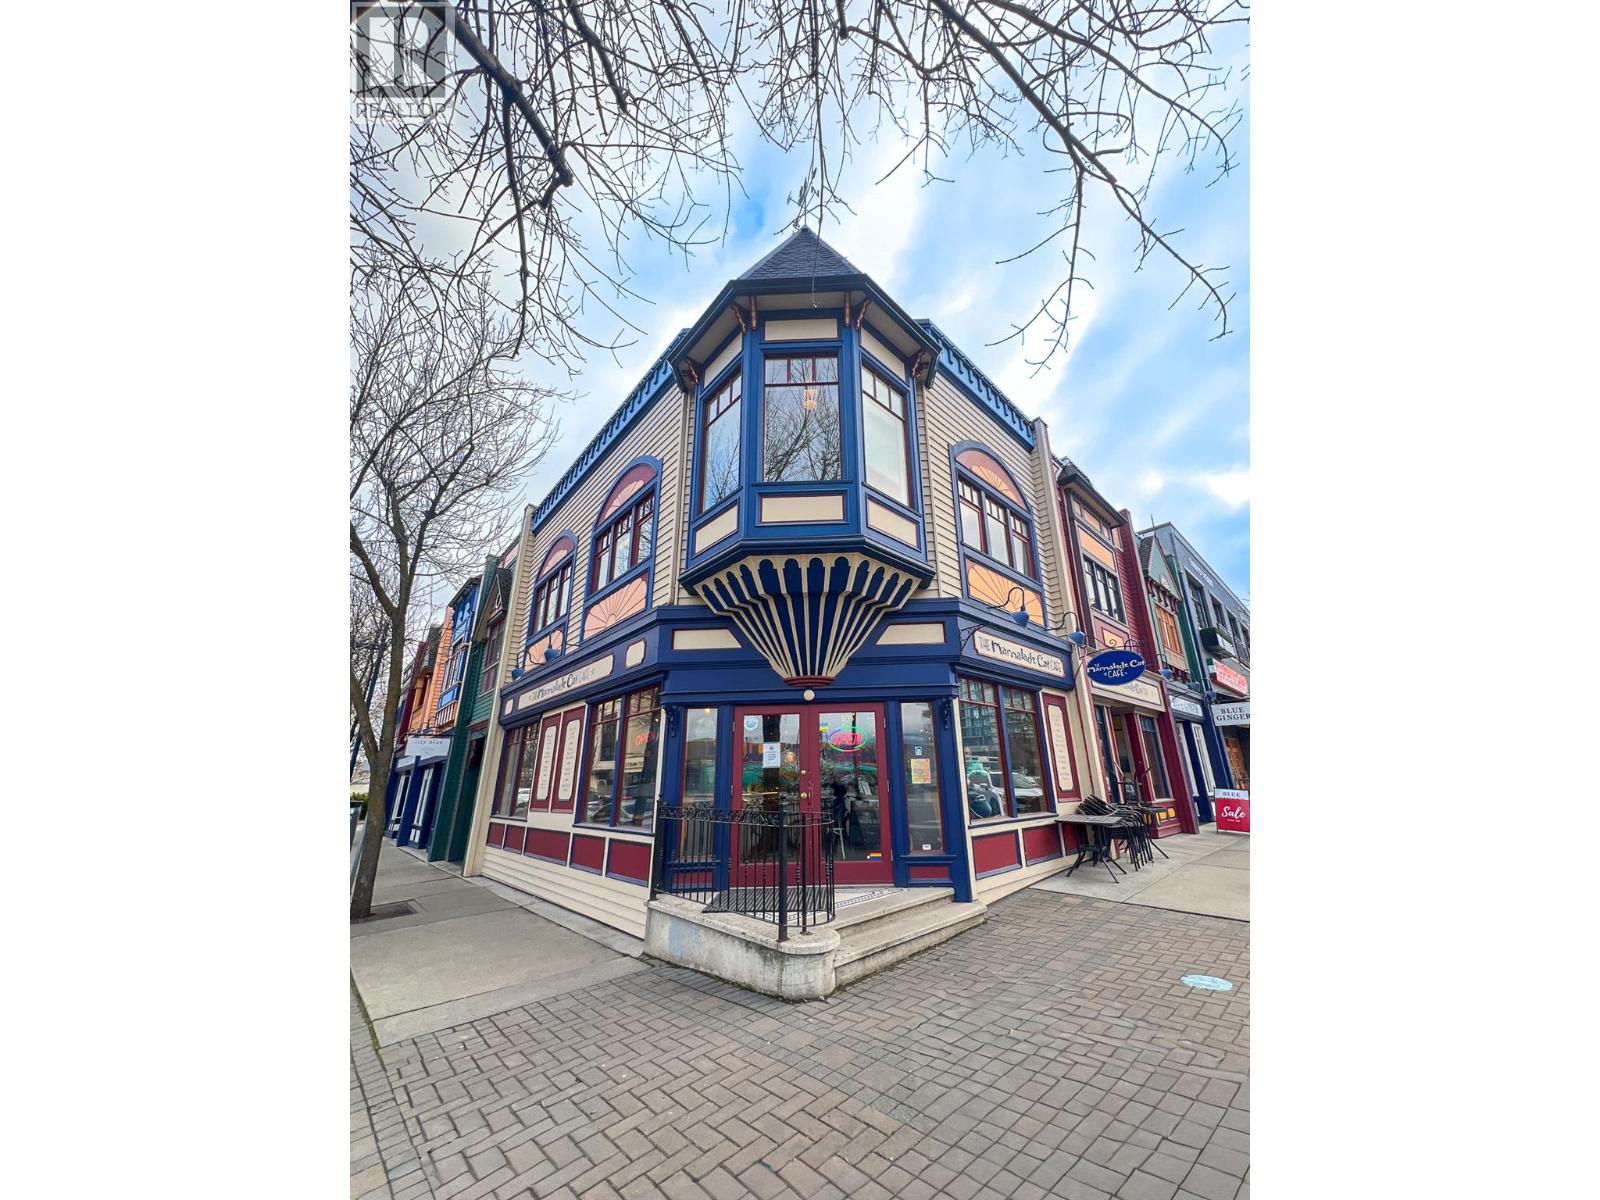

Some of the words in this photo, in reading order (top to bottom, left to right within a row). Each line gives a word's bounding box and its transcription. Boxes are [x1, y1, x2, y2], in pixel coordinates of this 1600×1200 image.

[1087, 662, 1129, 673] Marmalade
[1129, 659, 1145, 668] Cat
[1107, 669, 1125, 678] CAFE
[1220, 706, 1245, 714] BLUE
[635, 730, 657, 746] OPEN
[830, 732, 865, 747] OPEN
[1221, 805, 1247, 819] Sale
